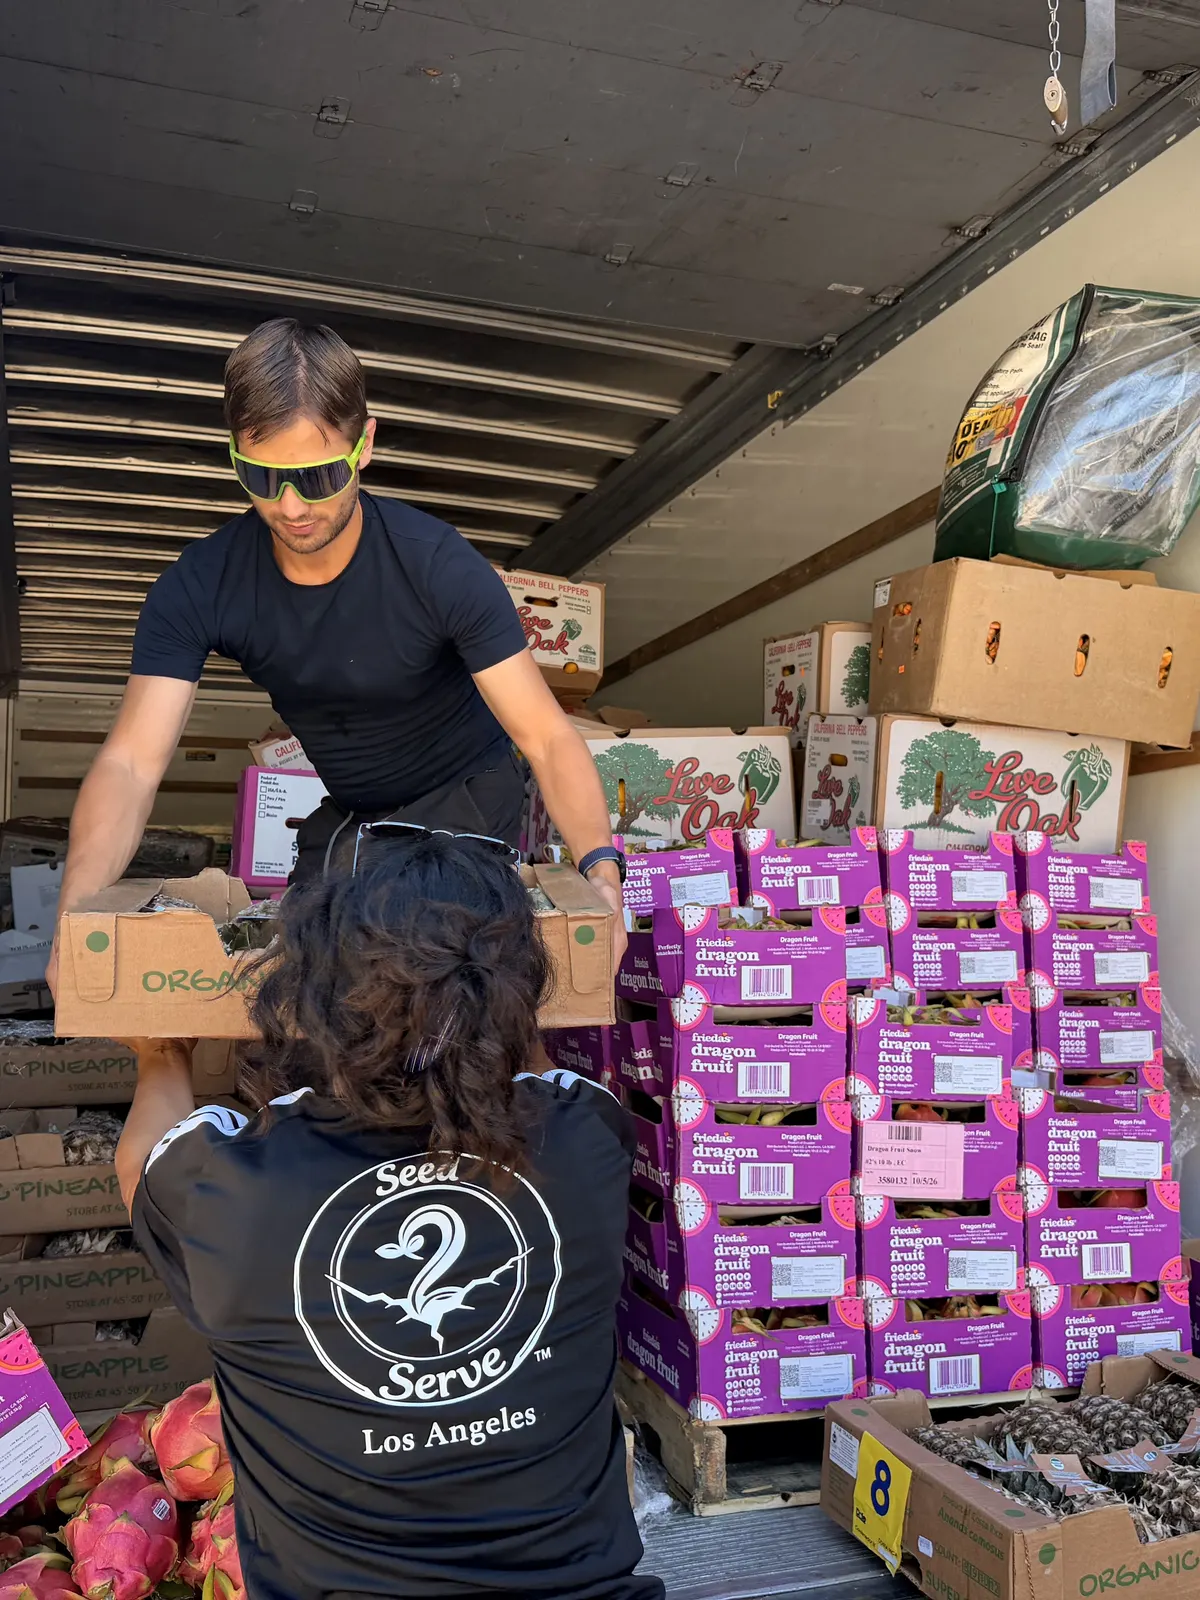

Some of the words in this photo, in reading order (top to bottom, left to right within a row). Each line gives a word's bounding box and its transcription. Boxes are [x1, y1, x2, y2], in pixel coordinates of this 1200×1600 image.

[500, 574, 536, 587] ALIFORNIA
[538, 580, 555, 590] BELL
[558, 584, 589, 597] PEPPERS
[836, 724, 846, 735] BELL
[847, 724, 868, 736] PEPPERS
[652, 757, 735, 807] Live
[812, 763, 843, 799] Live
[968, 750, 1058, 803] Live
[681, 789, 760, 841] Oak
[996, 789, 1082, 842] Oak
[760, 863, 812, 876] dragon
[908, 862, 950, 873] dragon
[1047, 863, 1088, 875] dragon
[622, 877, 652, 888] fruit
[761, 877, 795, 888] fruit
[909, 872, 936, 882] fruit
[1048, 874, 1075, 884] fruit
[912, 940, 955, 953] dragon
[1052, 940, 1094, 953] dragon
[695, 948, 759, 962] dragon
[913, 952, 940, 962] fruit
[1052, 951, 1080, 961] fruit
[695, 964, 737, 977] fruit
[620, 969, 648, 992] dragon
[1058, 1018, 1100, 1030] dragon
[1059, 1028, 1086, 1038] fruit
[691, 1043, 756, 1058] dragon
[878, 1038, 931, 1053] dragon
[878, 1051, 912, 1064] fruit
[23, 1057, 138, 1078] PINEAPPL
[691, 1059, 733, 1073] fruit
[1048, 1127, 1097, 1141] dragon
[692, 1144, 758, 1160] dragon
[1048, 1140, 1080, 1152] fruit
[632, 1158, 647, 1178] gon
[692, 1161, 735, 1175] fruit
[376, 1156, 459, 1197] Seed
[878, 1176, 908, 1185] 3580132
[912, 1177, 938, 1185] 10/5/26
[15, 1175, 120, 1202] PINEAP
[67, 1205, 98, 1217] STORE
[100, 1204, 112, 1213] AT
[890, 1236, 942, 1249] dragon
[1040, 1228, 1098, 1243] dragon
[713, 1244, 770, 1258] dragon
[890, 1249, 925, 1262] fruit
[1040, 1244, 1078, 1258] fruit
[714, 1258, 751, 1271] fruit
[1151, 1307, 1164, 1315] Fruit
[990, 1321, 1005, 1329] Fruit
[1065, 1323, 1115, 1338] dragon
[884, 1340, 946, 1355] dragon
[1065, 1338, 1098, 1352] fruit
[627, 1331, 656, 1374] dragon
[656, 1356, 680, 1389] fruit
[725, 1349, 779, 1364] dragon
[53, 1355, 169, 1380] NEAPPLE
[725, 1364, 760, 1378] fruit
[884, 1357, 925, 1373] fruit
[379, 1348, 506, 1400] Serve
[362, 1428, 415, 1454] Los
[424, 1407, 537, 1446] Angeles
[871, 1459, 891, 1517] 8
[972, 1512, 989, 1528] Costa
[938, 1507, 968, 1535] Ananas
[969, 1530, 1004, 1560] comosus
[1079, 1548, 1200, 1597] ORGANIC
